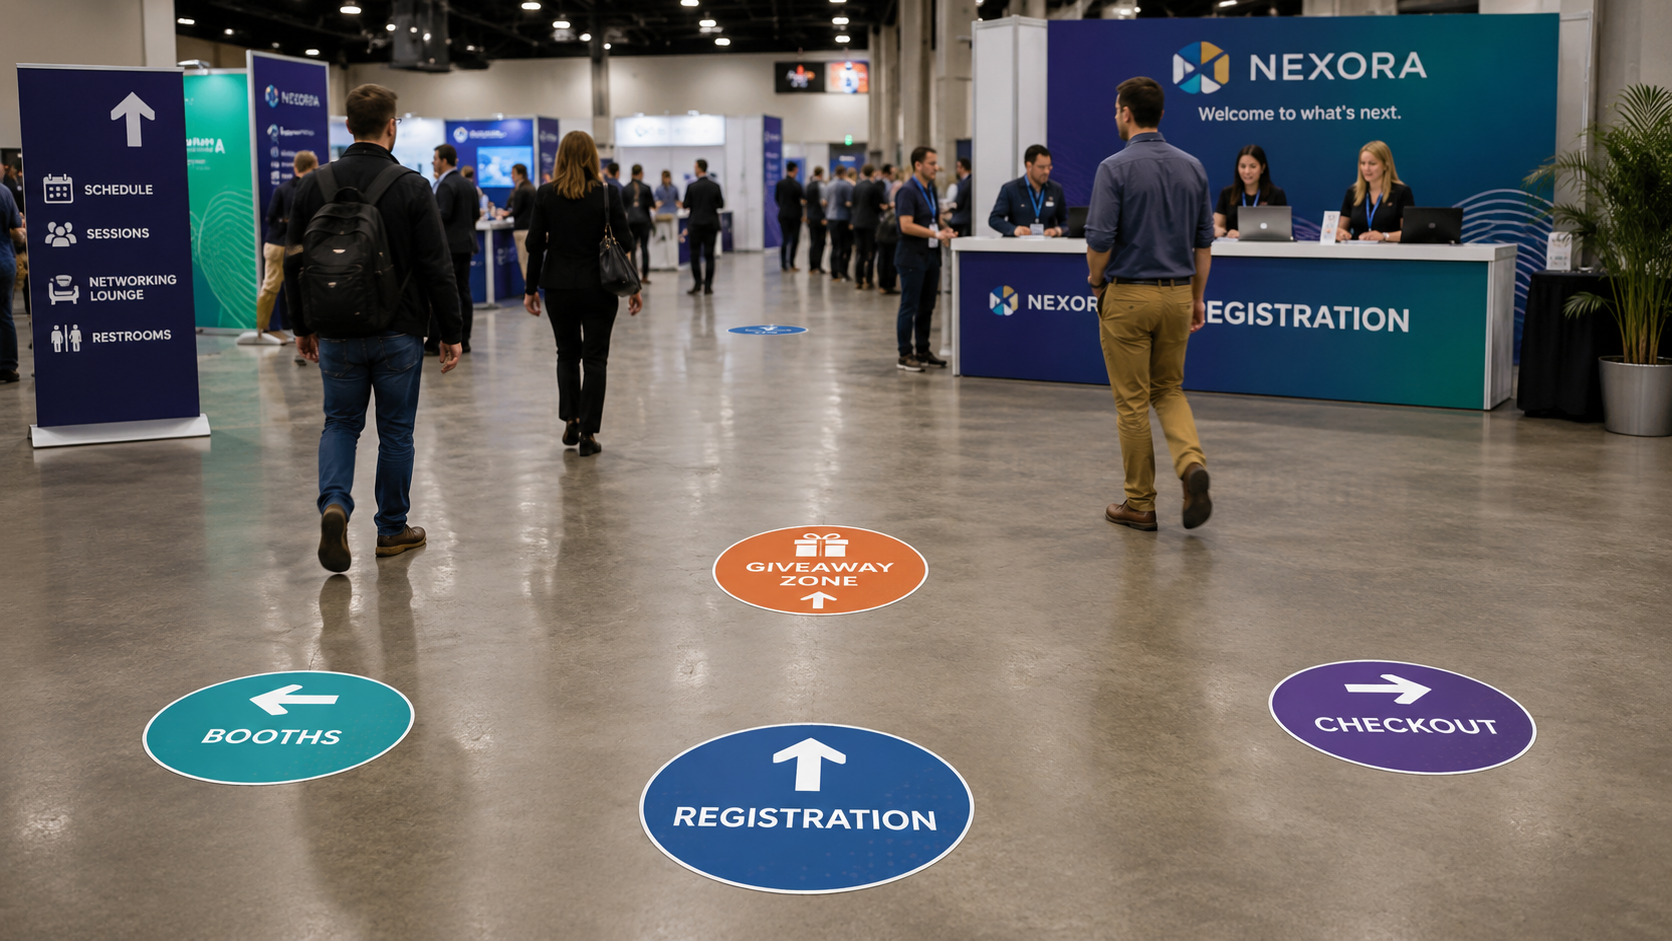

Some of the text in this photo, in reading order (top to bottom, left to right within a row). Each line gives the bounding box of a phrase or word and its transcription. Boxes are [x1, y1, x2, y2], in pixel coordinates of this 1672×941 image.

[1250, 51, 1428, 81] NEXORA
[1198, 104, 1402, 121] Welcome to what's next.
[84, 184, 154, 196] SCHEDULE
[86, 227, 150, 240] SESSIONS
[89, 274, 177, 288] NETWORKING
[90, 288, 144, 302] LOUNGE
[1027, 294, 1098, 312] NEXOR
[1206, 300, 1410, 333] EGISTRATION
[92, 329, 172, 343] RESTROOMS
[745, 561, 894, 573] GIVEAWAY
[779, 575, 858, 587] ZONE
[1315, 717, 1497, 734] CHECKOUT
[201, 728, 342, 745] BOOTHS
[672, 806, 937, 831] REGISTRATION
